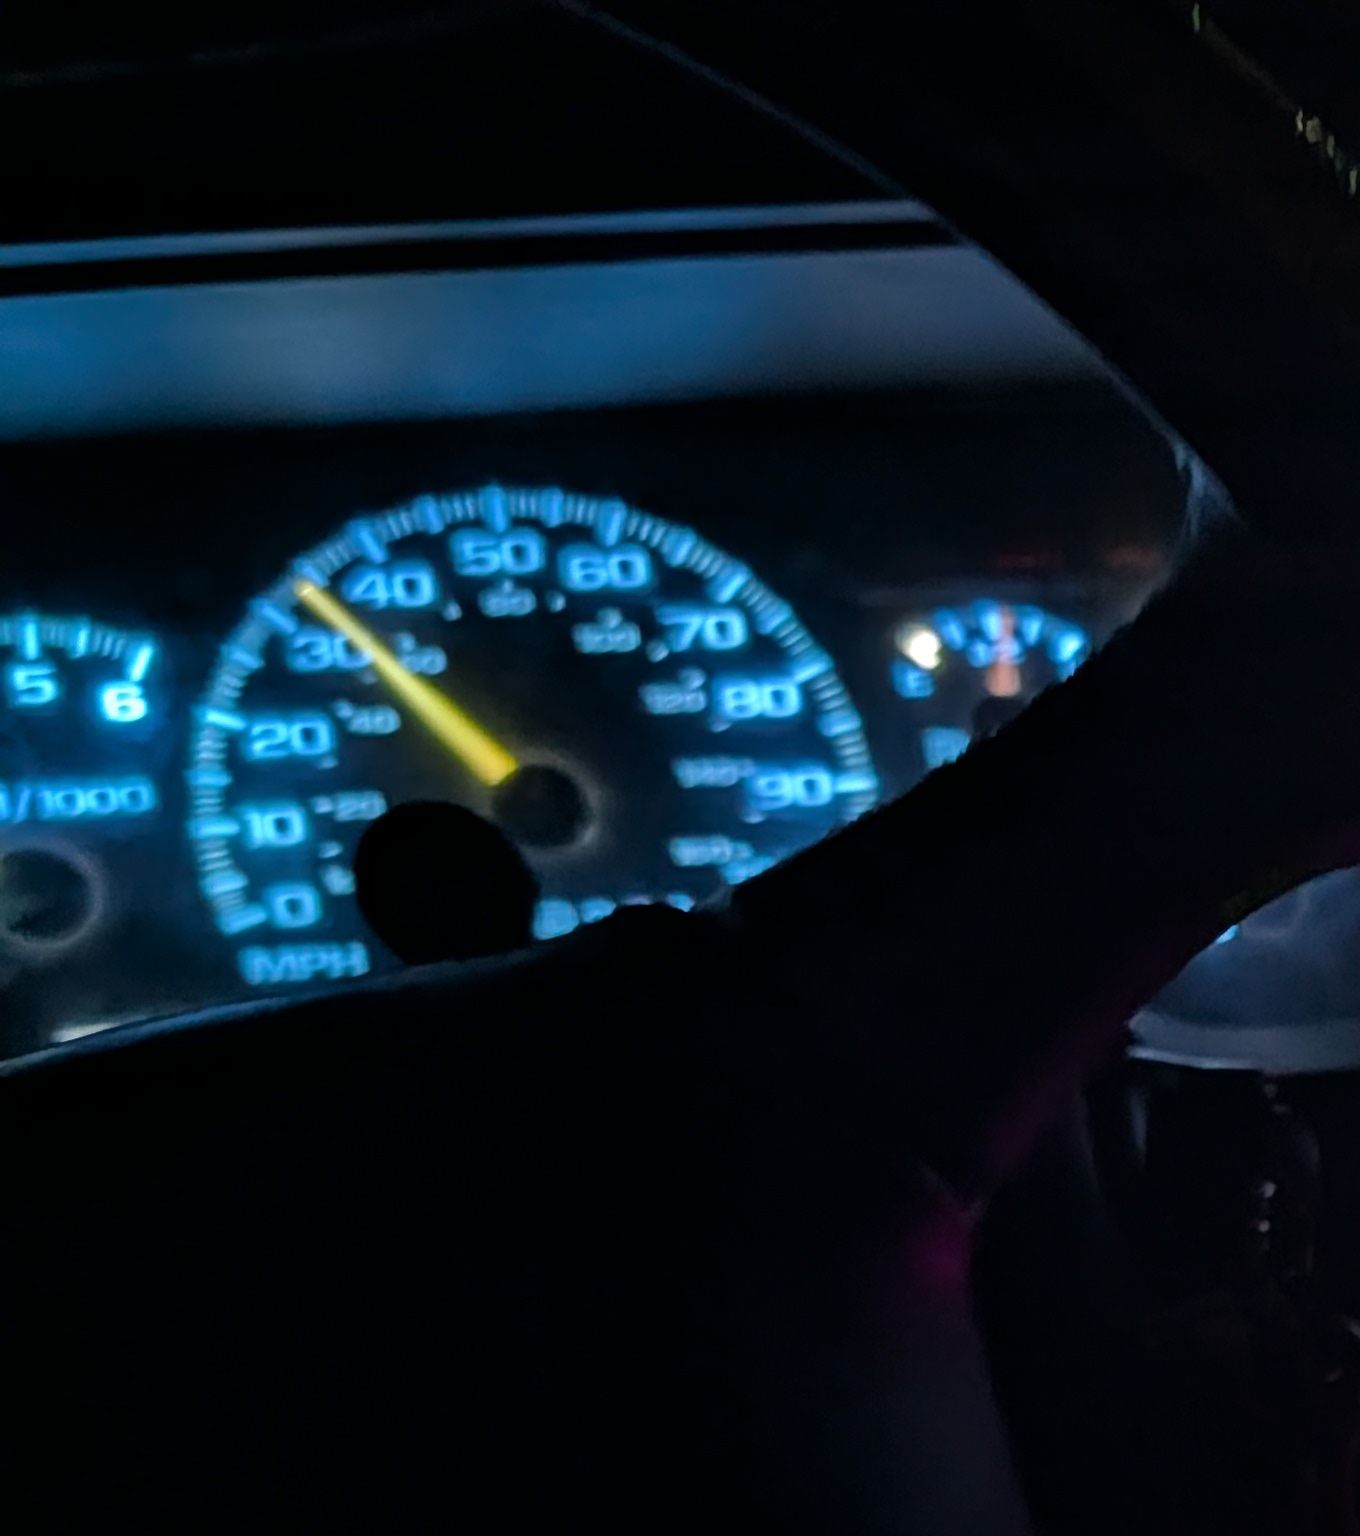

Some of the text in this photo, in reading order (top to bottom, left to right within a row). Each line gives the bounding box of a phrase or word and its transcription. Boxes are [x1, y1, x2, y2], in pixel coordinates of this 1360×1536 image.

[453, 529, 545, 575] 50
[560, 546, 650, 590] 60
[345, 562, 435, 607] 40
[288, 628, 374, 671] 30
[655, 606, 750, 650] 70
[12, 663, 56, 704] 5
[100, 683, 148, 722] 6
[716, 678, 800, 719] 80
[247, 716, 334, 760] 20
[747, 767, 834, 809] 90
[245, 804, 307, 848] 10
[266, 886, 322, 928] 0
[240, 943, 370, 984] MPH
